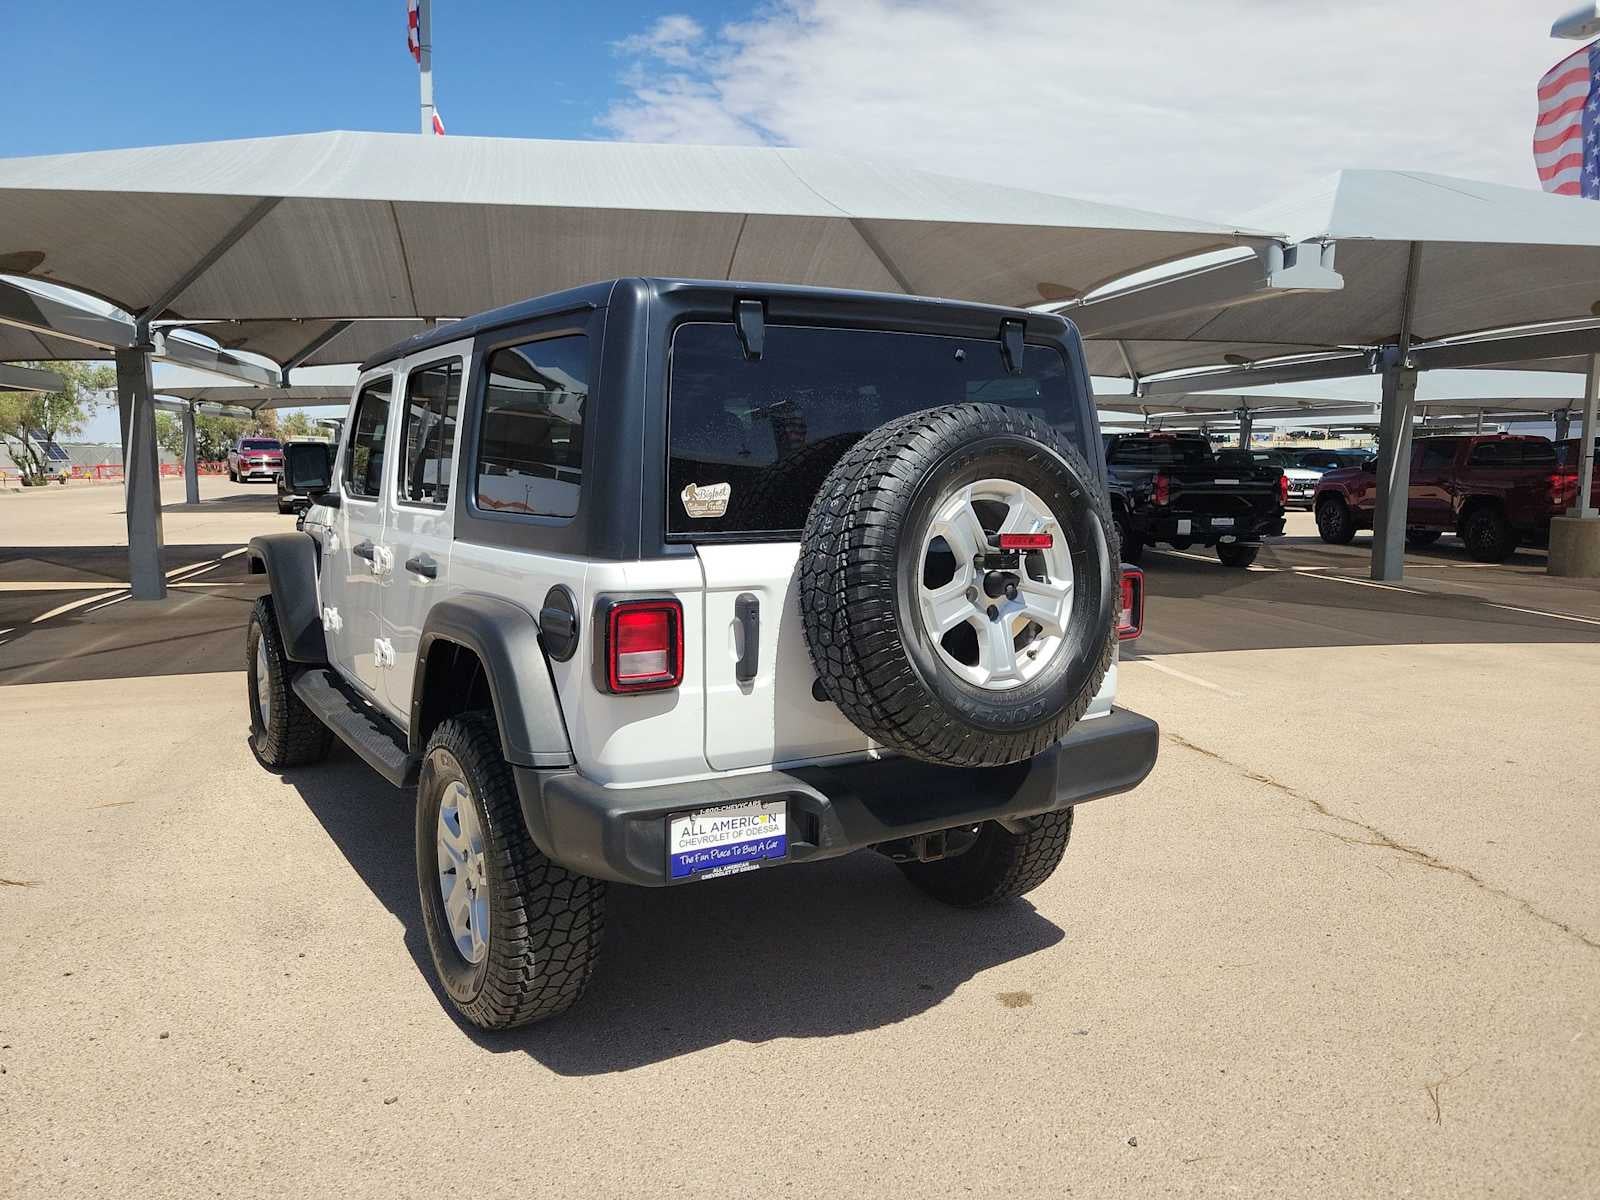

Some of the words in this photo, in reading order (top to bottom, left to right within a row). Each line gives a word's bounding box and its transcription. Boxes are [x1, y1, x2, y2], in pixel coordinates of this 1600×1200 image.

[678, 832, 730, 848] CHEVROLET
[732, 829, 744, 839] OF
[746, 824, 780, 837] ODESSA
[681, 824, 706, 838] ALL
[710, 812, 777, 833] AMERICN
[680, 855, 694, 865] The
[710, 849, 731, 860] Place
[731, 846, 741, 855] To
[742, 844, 757, 855] Buy
[758, 841, 765, 851] A
[765, 840, 778, 850] Car
